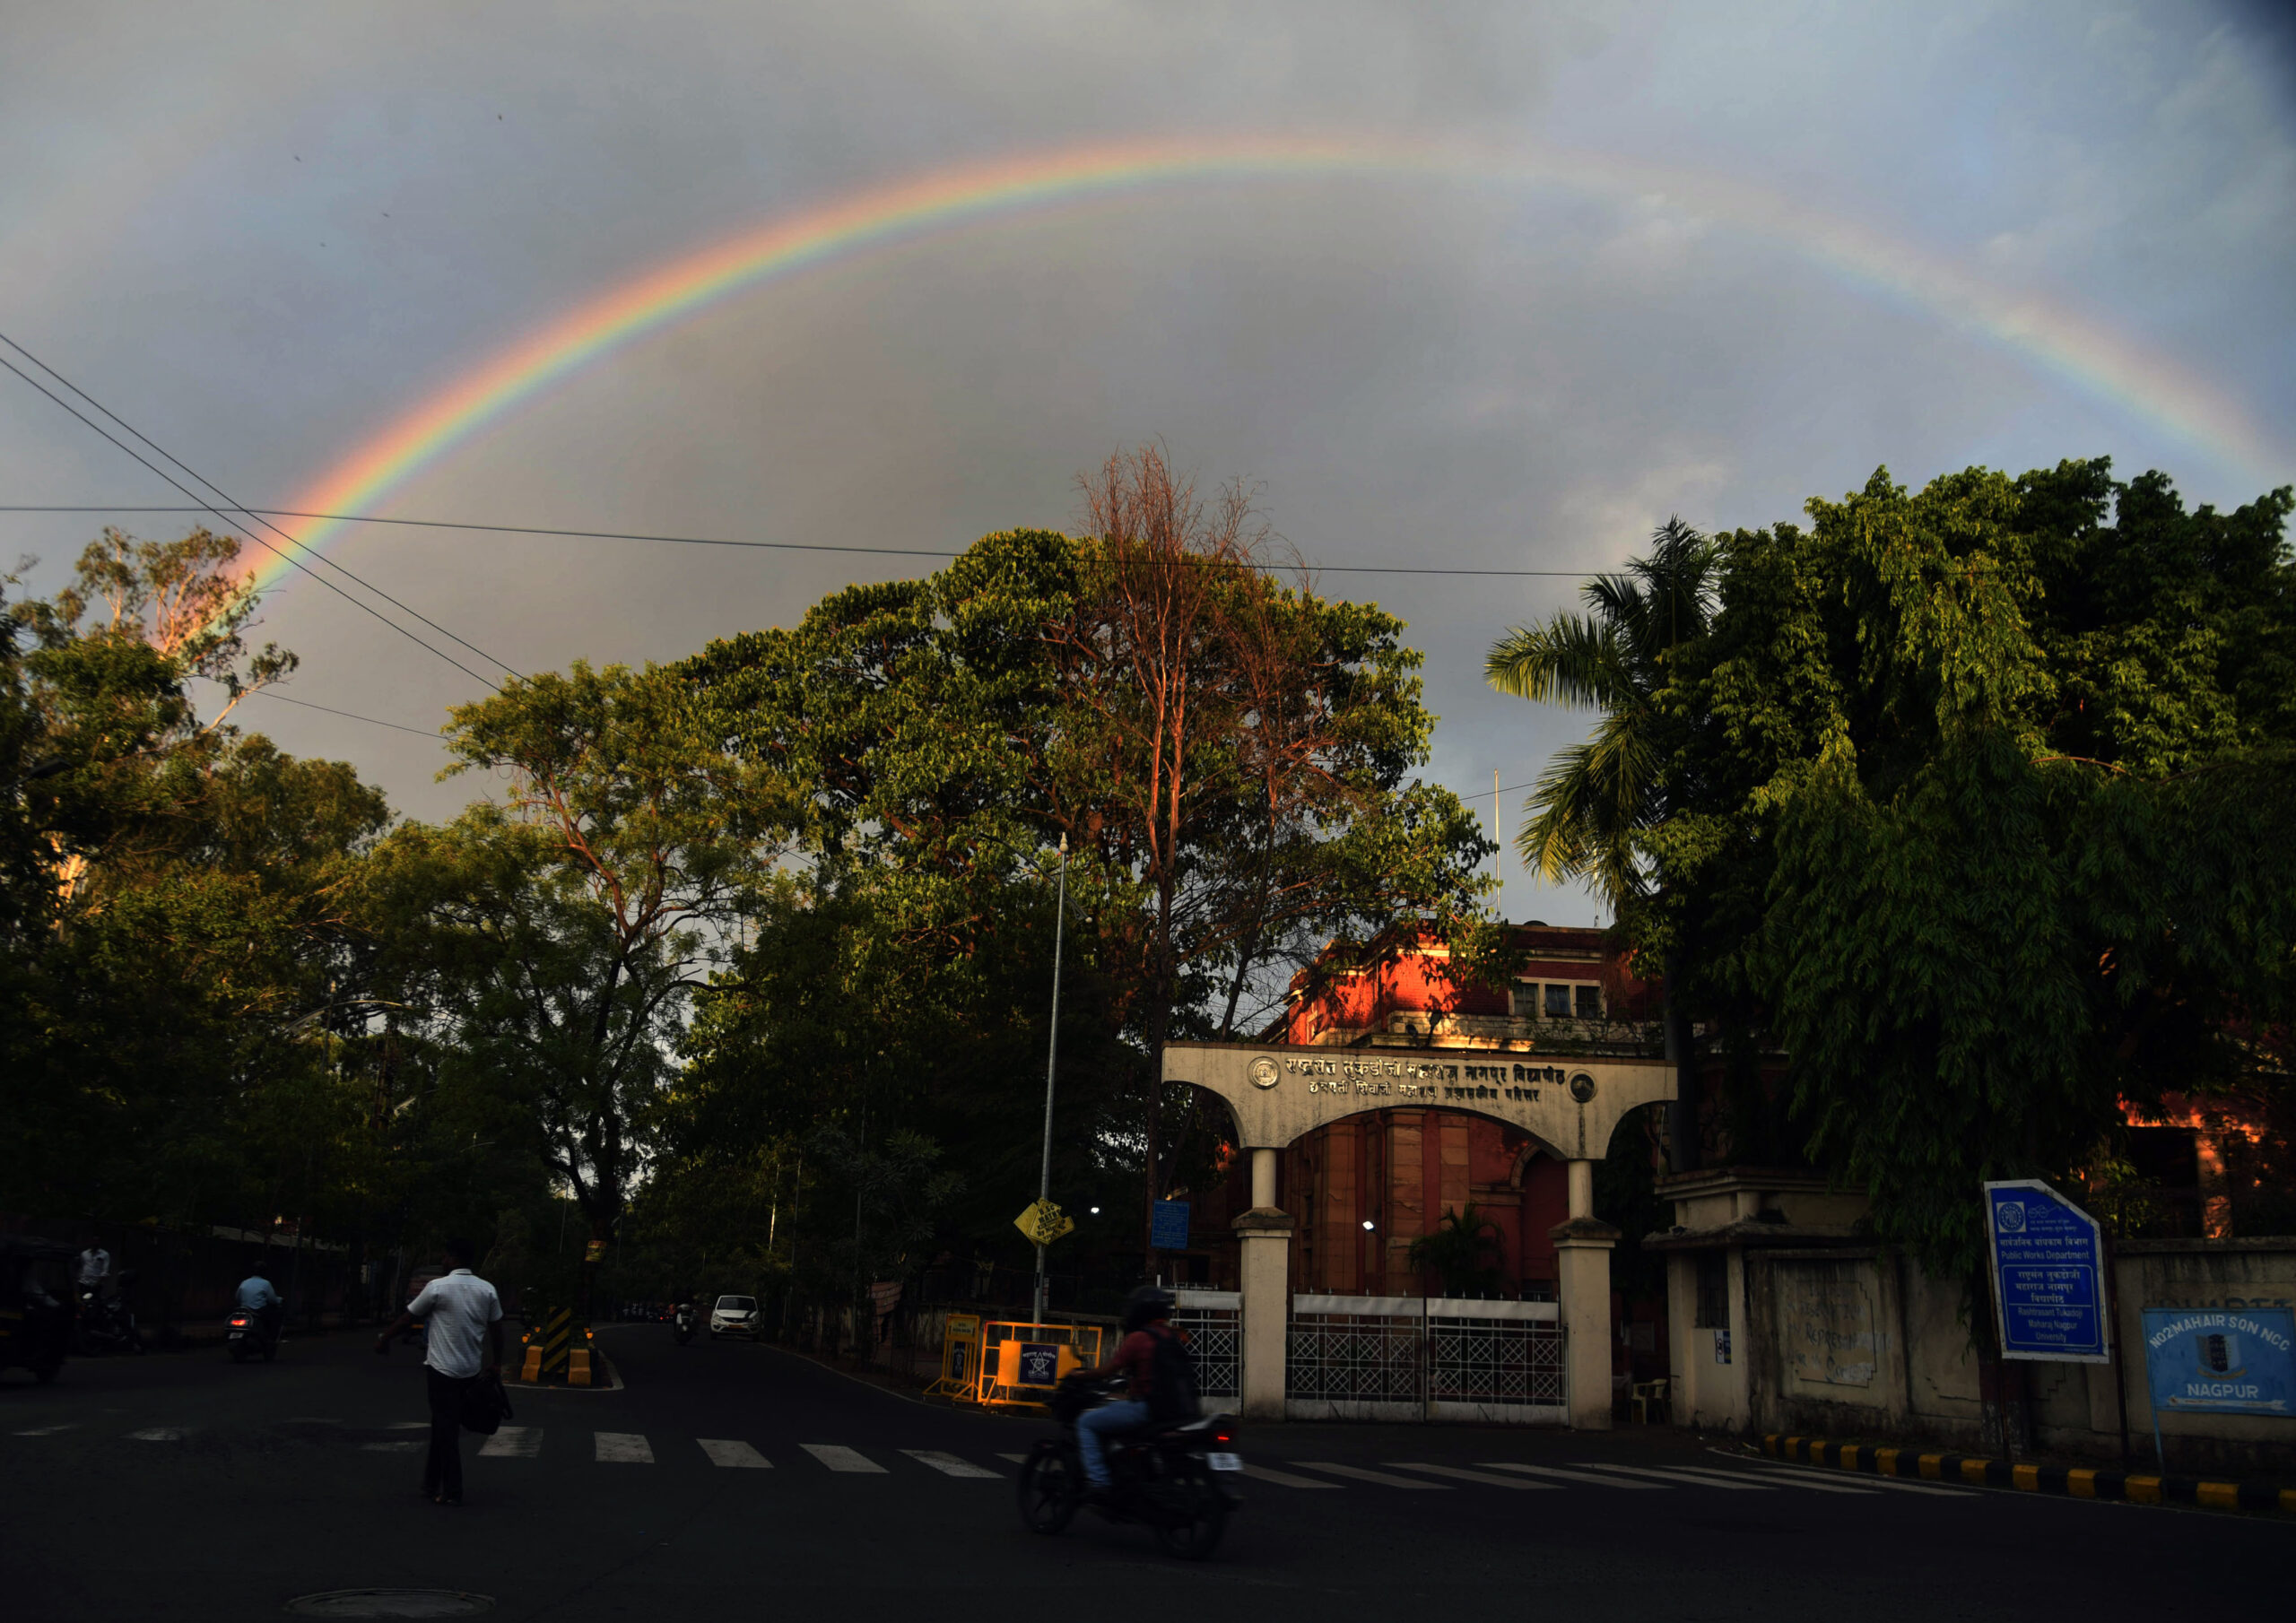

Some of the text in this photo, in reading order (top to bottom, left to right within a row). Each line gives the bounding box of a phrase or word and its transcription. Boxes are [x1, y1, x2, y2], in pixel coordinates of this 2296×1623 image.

[1285, 1057, 1565, 1086] राष्ट्रसंत तुकडोजी महाराज नागपूर विद्यापीठ
[1309, 1080, 1348, 1094] छत्रपती
[1355, 1080, 1392, 1096] शिवाजी
[1398, 1083, 1437, 1098] महाराज
[2065, 1235, 2088, 1246] विभाग
[2001, 1250, 2090, 1262] Public Works Department
[2031, 1292, 2065, 1304] विद्यापीठ
[2017, 1306, 2083, 1319] Rashtrasant Tukadoji
[2028, 1319, 2078, 1332] Maharaj Nagpur
[2035, 1332, 2066, 1343] University
[2228, 1315, 2259, 1335] SQN
[2260, 1327, 2290, 1351] NCC
[2187, 1384, 2259, 1399] NAGPUR
